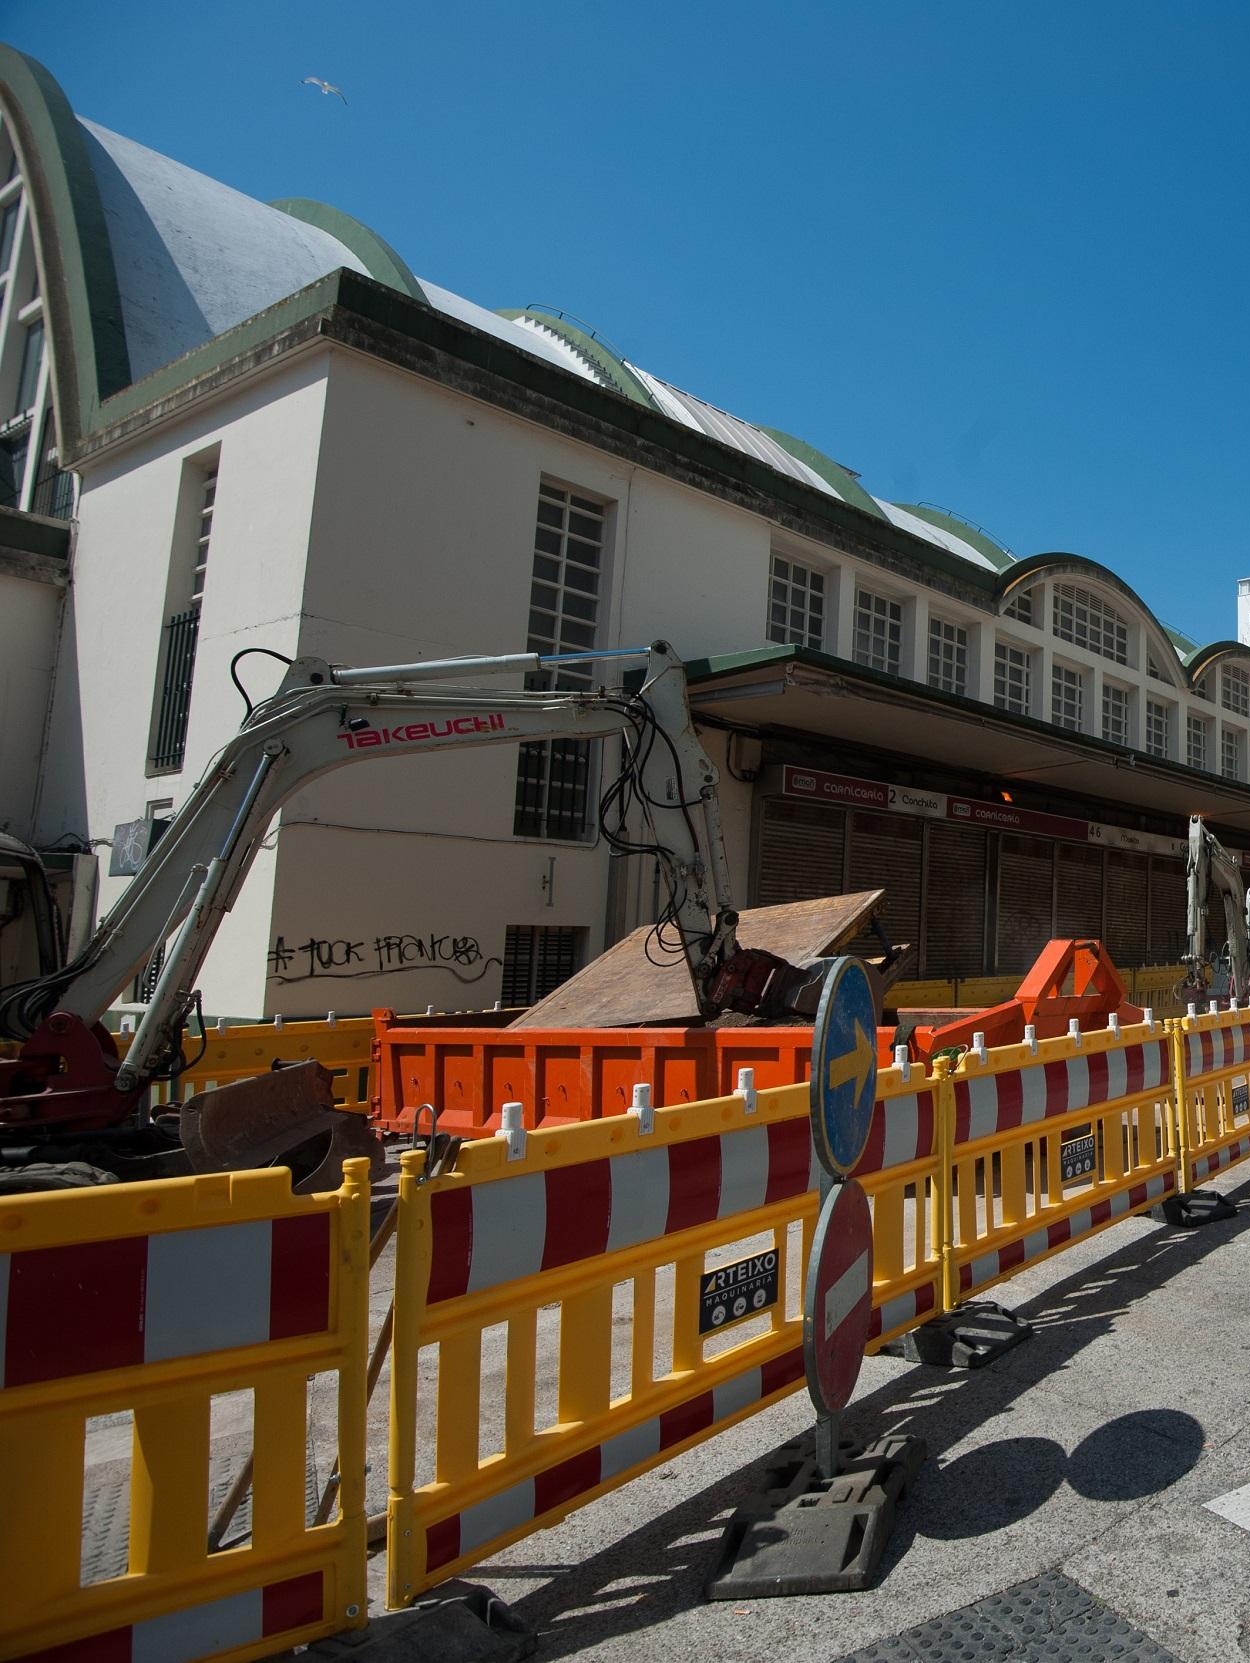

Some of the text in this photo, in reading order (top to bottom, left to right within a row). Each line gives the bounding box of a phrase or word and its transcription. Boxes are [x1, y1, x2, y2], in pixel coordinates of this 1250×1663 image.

[336, 713, 505, 749] TAKEUCHI
[888, 789, 897, 804] 2
[902, 794, 939, 810] Conchita
[1062, 1137, 1095, 1158] ARTEIXO
[704, 1253, 776, 1294] ARTEIXO
[705, 1275, 772, 1307] MAQUINARIA
